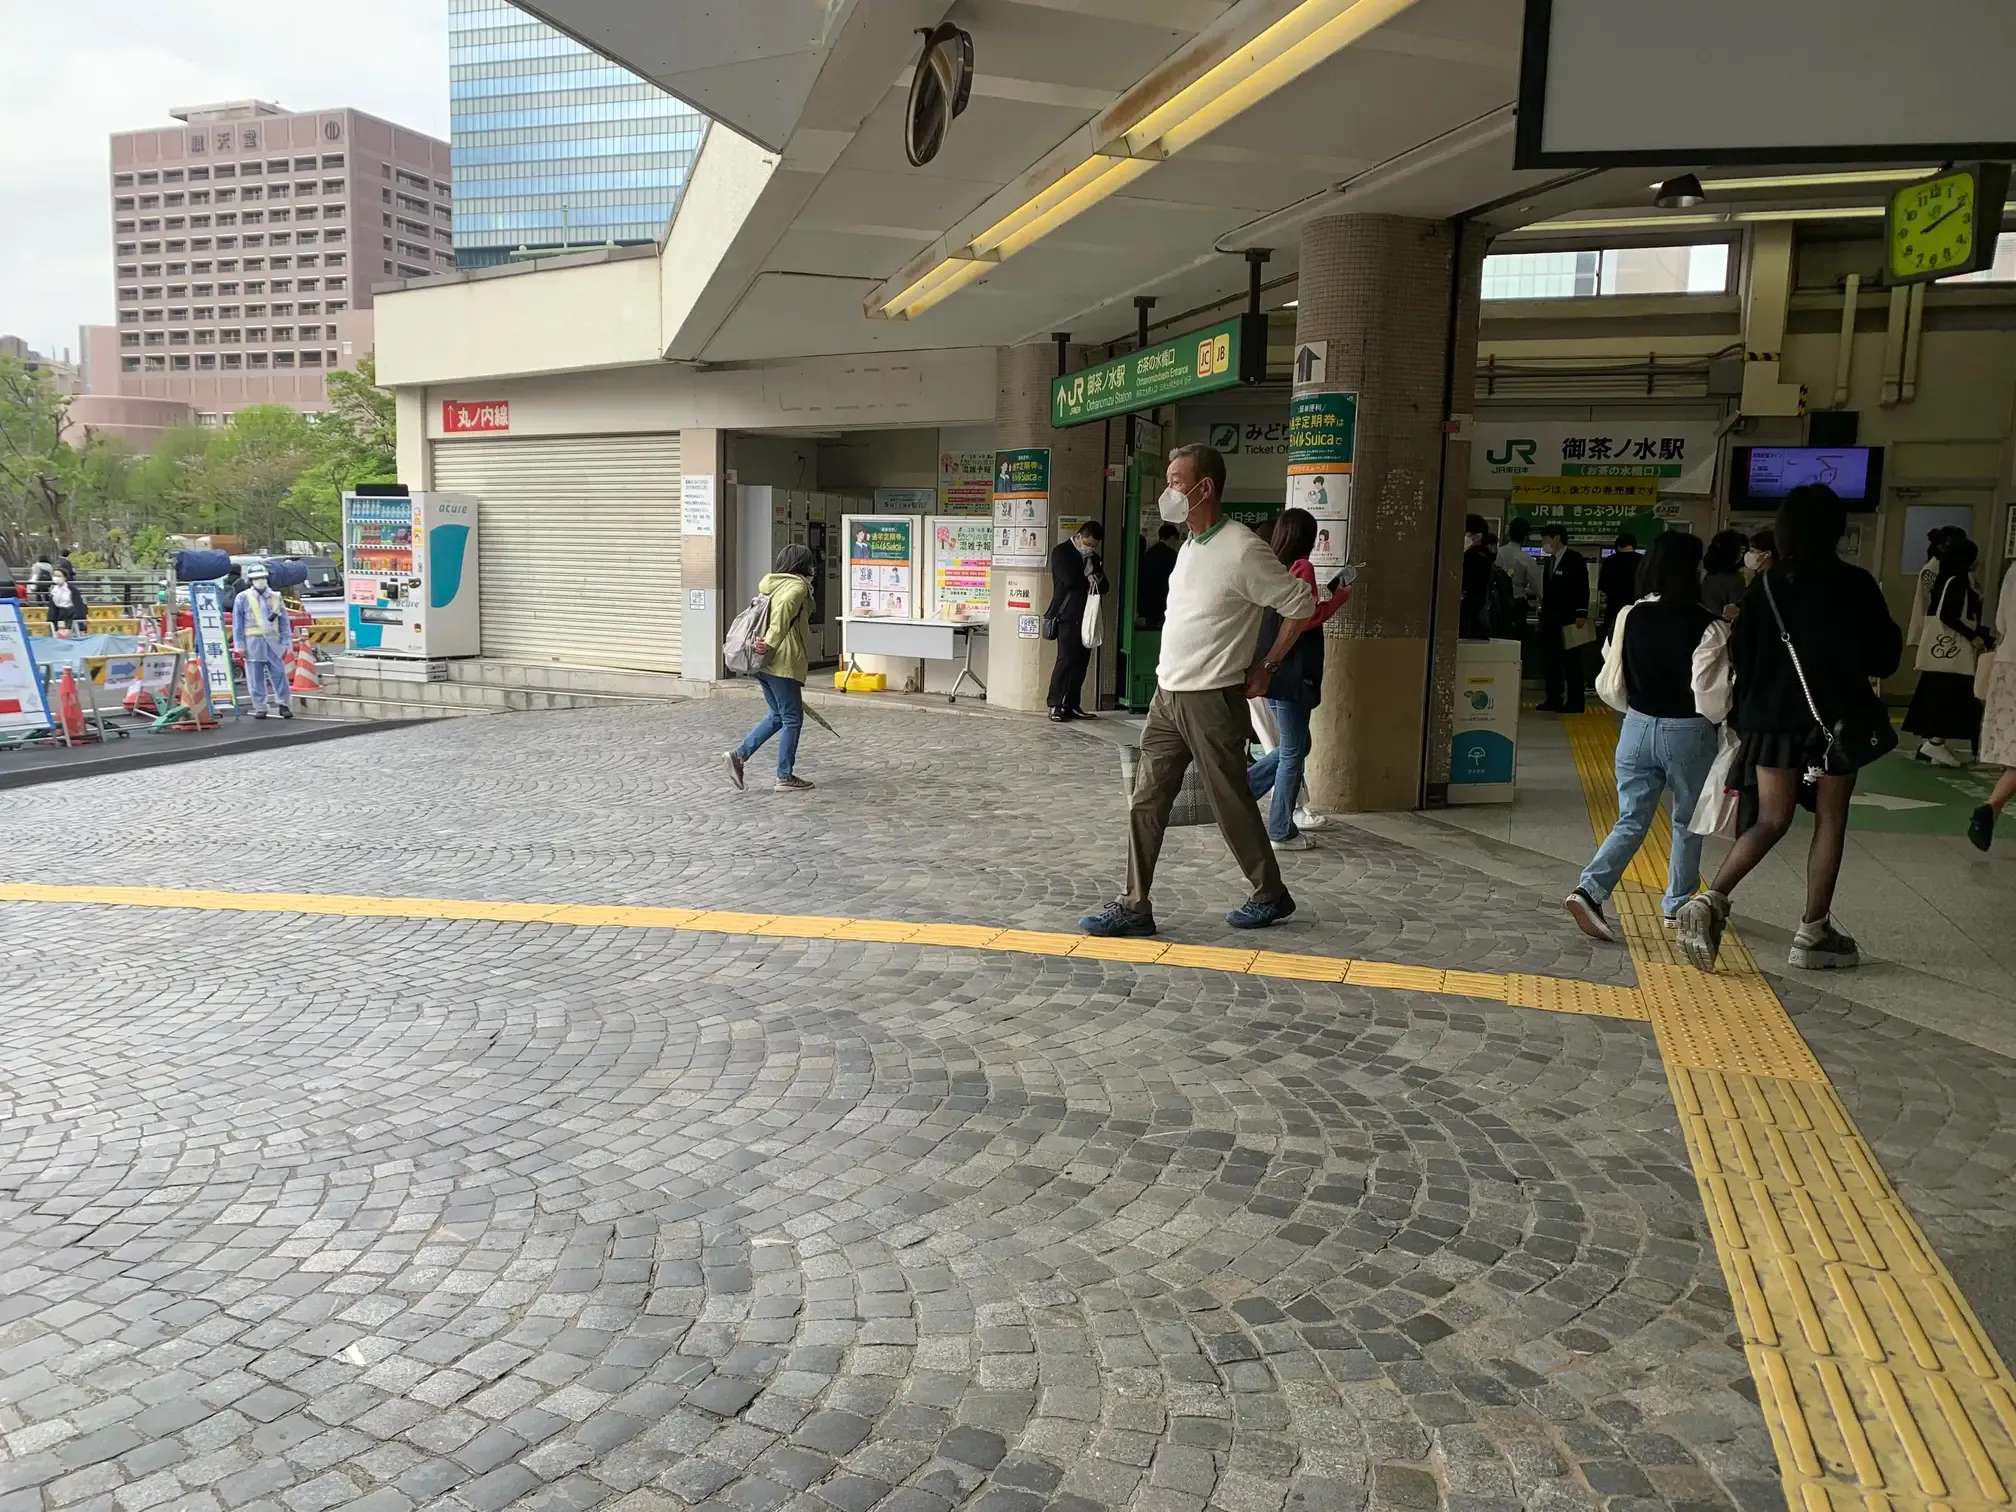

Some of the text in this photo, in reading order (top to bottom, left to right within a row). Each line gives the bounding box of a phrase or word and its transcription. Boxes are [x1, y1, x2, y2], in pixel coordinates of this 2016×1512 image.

[1136, 348, 1176, 375] お茶の水橋口
[1200, 350, 1210, 366] JC
[1216, 346, 1226, 362] JB
[1087, 364, 1126, 396] 御茶ノ水駅
[1170, 365, 1189, 379] Entrance
[1068, 377, 1085, 406] JR
[1086, 391, 1133, 412] Ochanomizu Station
[457, 405, 508, 428] 丸ノ内線
[1244, 446, 1274, 455] Ticket
[1486, 439, 1537, 465] JR
[1562, 437, 1685, 461] 御茶ノ水駅
[1491, 466, 1530, 474] JR東日本
[1512, 484, 1656, 497] チャージは、後方の券売機です
[438, 503, 468, 514] acure
[1531, 505, 1637, 517] JR線 きっぷうりば
[395, 599, 420, 608] acure
[202, 615, 228, 686] 工事中
